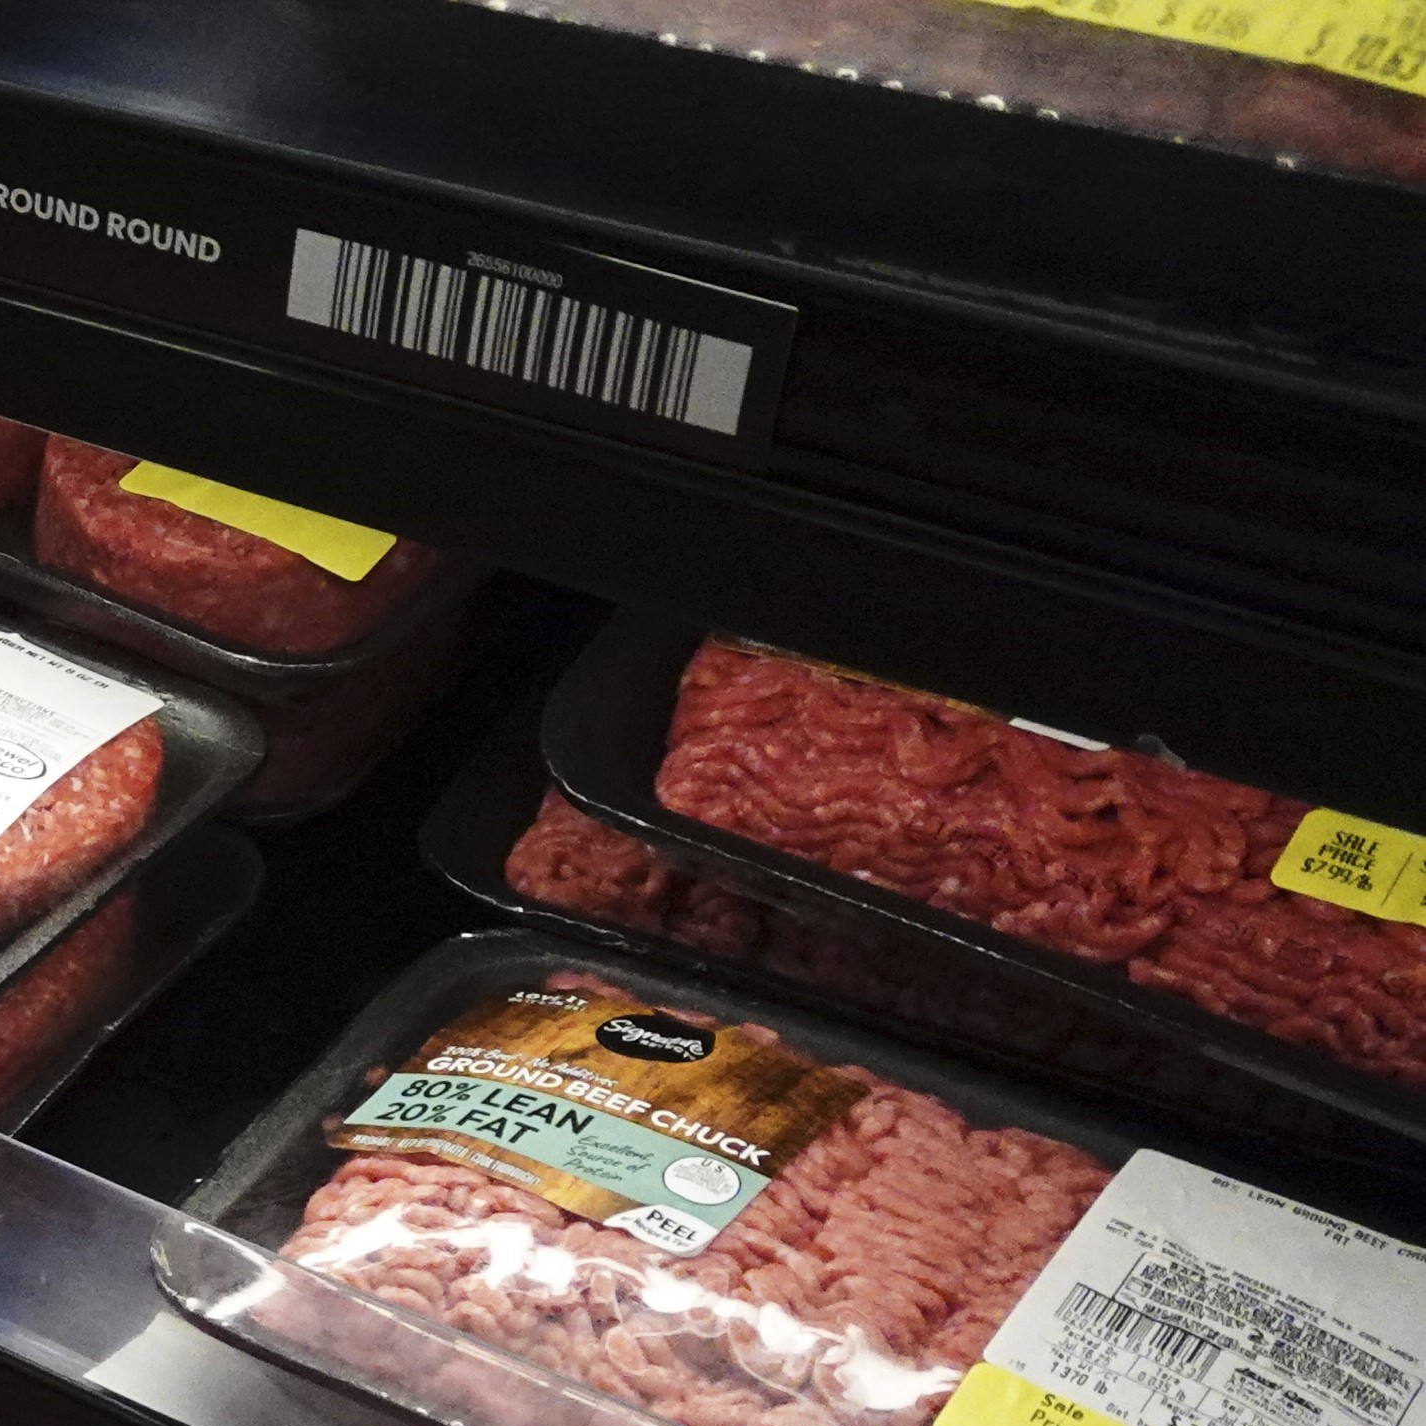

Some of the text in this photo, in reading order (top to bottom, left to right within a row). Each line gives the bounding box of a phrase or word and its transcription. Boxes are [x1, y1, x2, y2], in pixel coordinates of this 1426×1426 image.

[106, 212, 221, 264] ROUND
[374, 1102, 540, 1144] 20% FAT
[401, 1080, 595, 1135] 80% LEAN
[426, 1056, 772, 1166] GROUND BEEF CHUCK
[646, 1209, 698, 1242] PEEL
[1041, 1393, 1084, 1421] Sale
